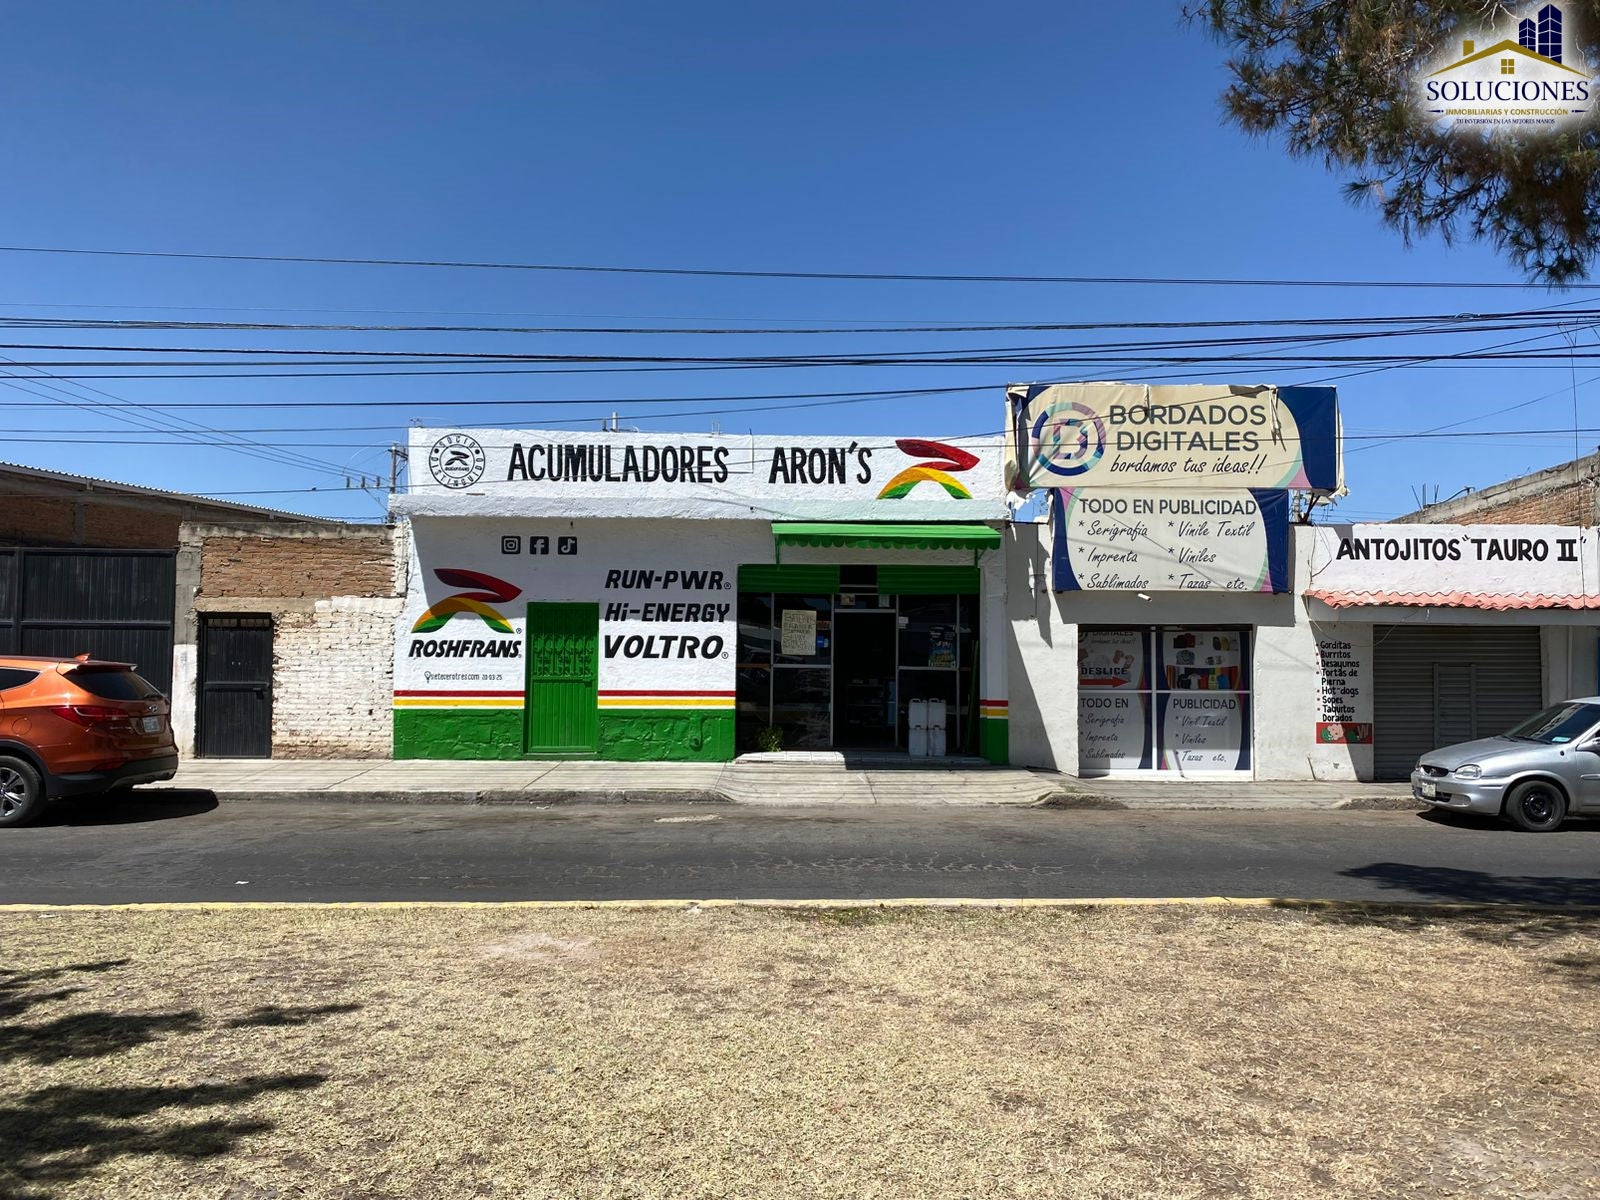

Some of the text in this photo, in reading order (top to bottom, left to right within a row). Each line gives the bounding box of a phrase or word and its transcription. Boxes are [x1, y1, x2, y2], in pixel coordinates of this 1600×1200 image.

[1109, 405, 1266, 426] BORDADOS
[439, 436, 475, 448] SOCIO
[1116, 431, 1259, 452] DIGITALES
[507, 441, 872, 484] ACUMULADORES ARON'S
[1110, 454, 1177, 474] bordamos
[1184, 456, 1206, 473] tus
[1079, 498, 1256, 515] TODO EN PUBLICIDAD
[1178, 520, 1254, 537] Vinile Textil
[1178, 548, 1216, 564] Viniles
[1336, 538, 1462, 560] ANTOJITOS
[1088, 547, 1138, 568] Imprenta
[1088, 574, 1150, 590] Sublimados
[1179, 574, 1247, 590] Tazas etc.
[408, 640, 522, 658] ROSHFRANS
[604, 634, 724, 659] VOLTRO
[1320, 640, 1352, 650] Gorditas
[1320, 650, 1351, 659] Burritos
[1321, 660, 1360, 670] Desayunos
[1321, 668, 1358, 677] Tortas de
[1322, 678, 1346, 686] Pierna
[1080, 698, 1236, 710] TODO EN PUBLICIDAD
[1322, 696, 1344, 706] Sopes
[1322, 704, 1355, 716] Taquitos
[1322, 714, 1353, 722] Dorados
[1085, 731, 1118, 745] Imprenta
[1085, 748, 1126, 760] Sublimados
[1181, 751, 1202, 762] Tazas
